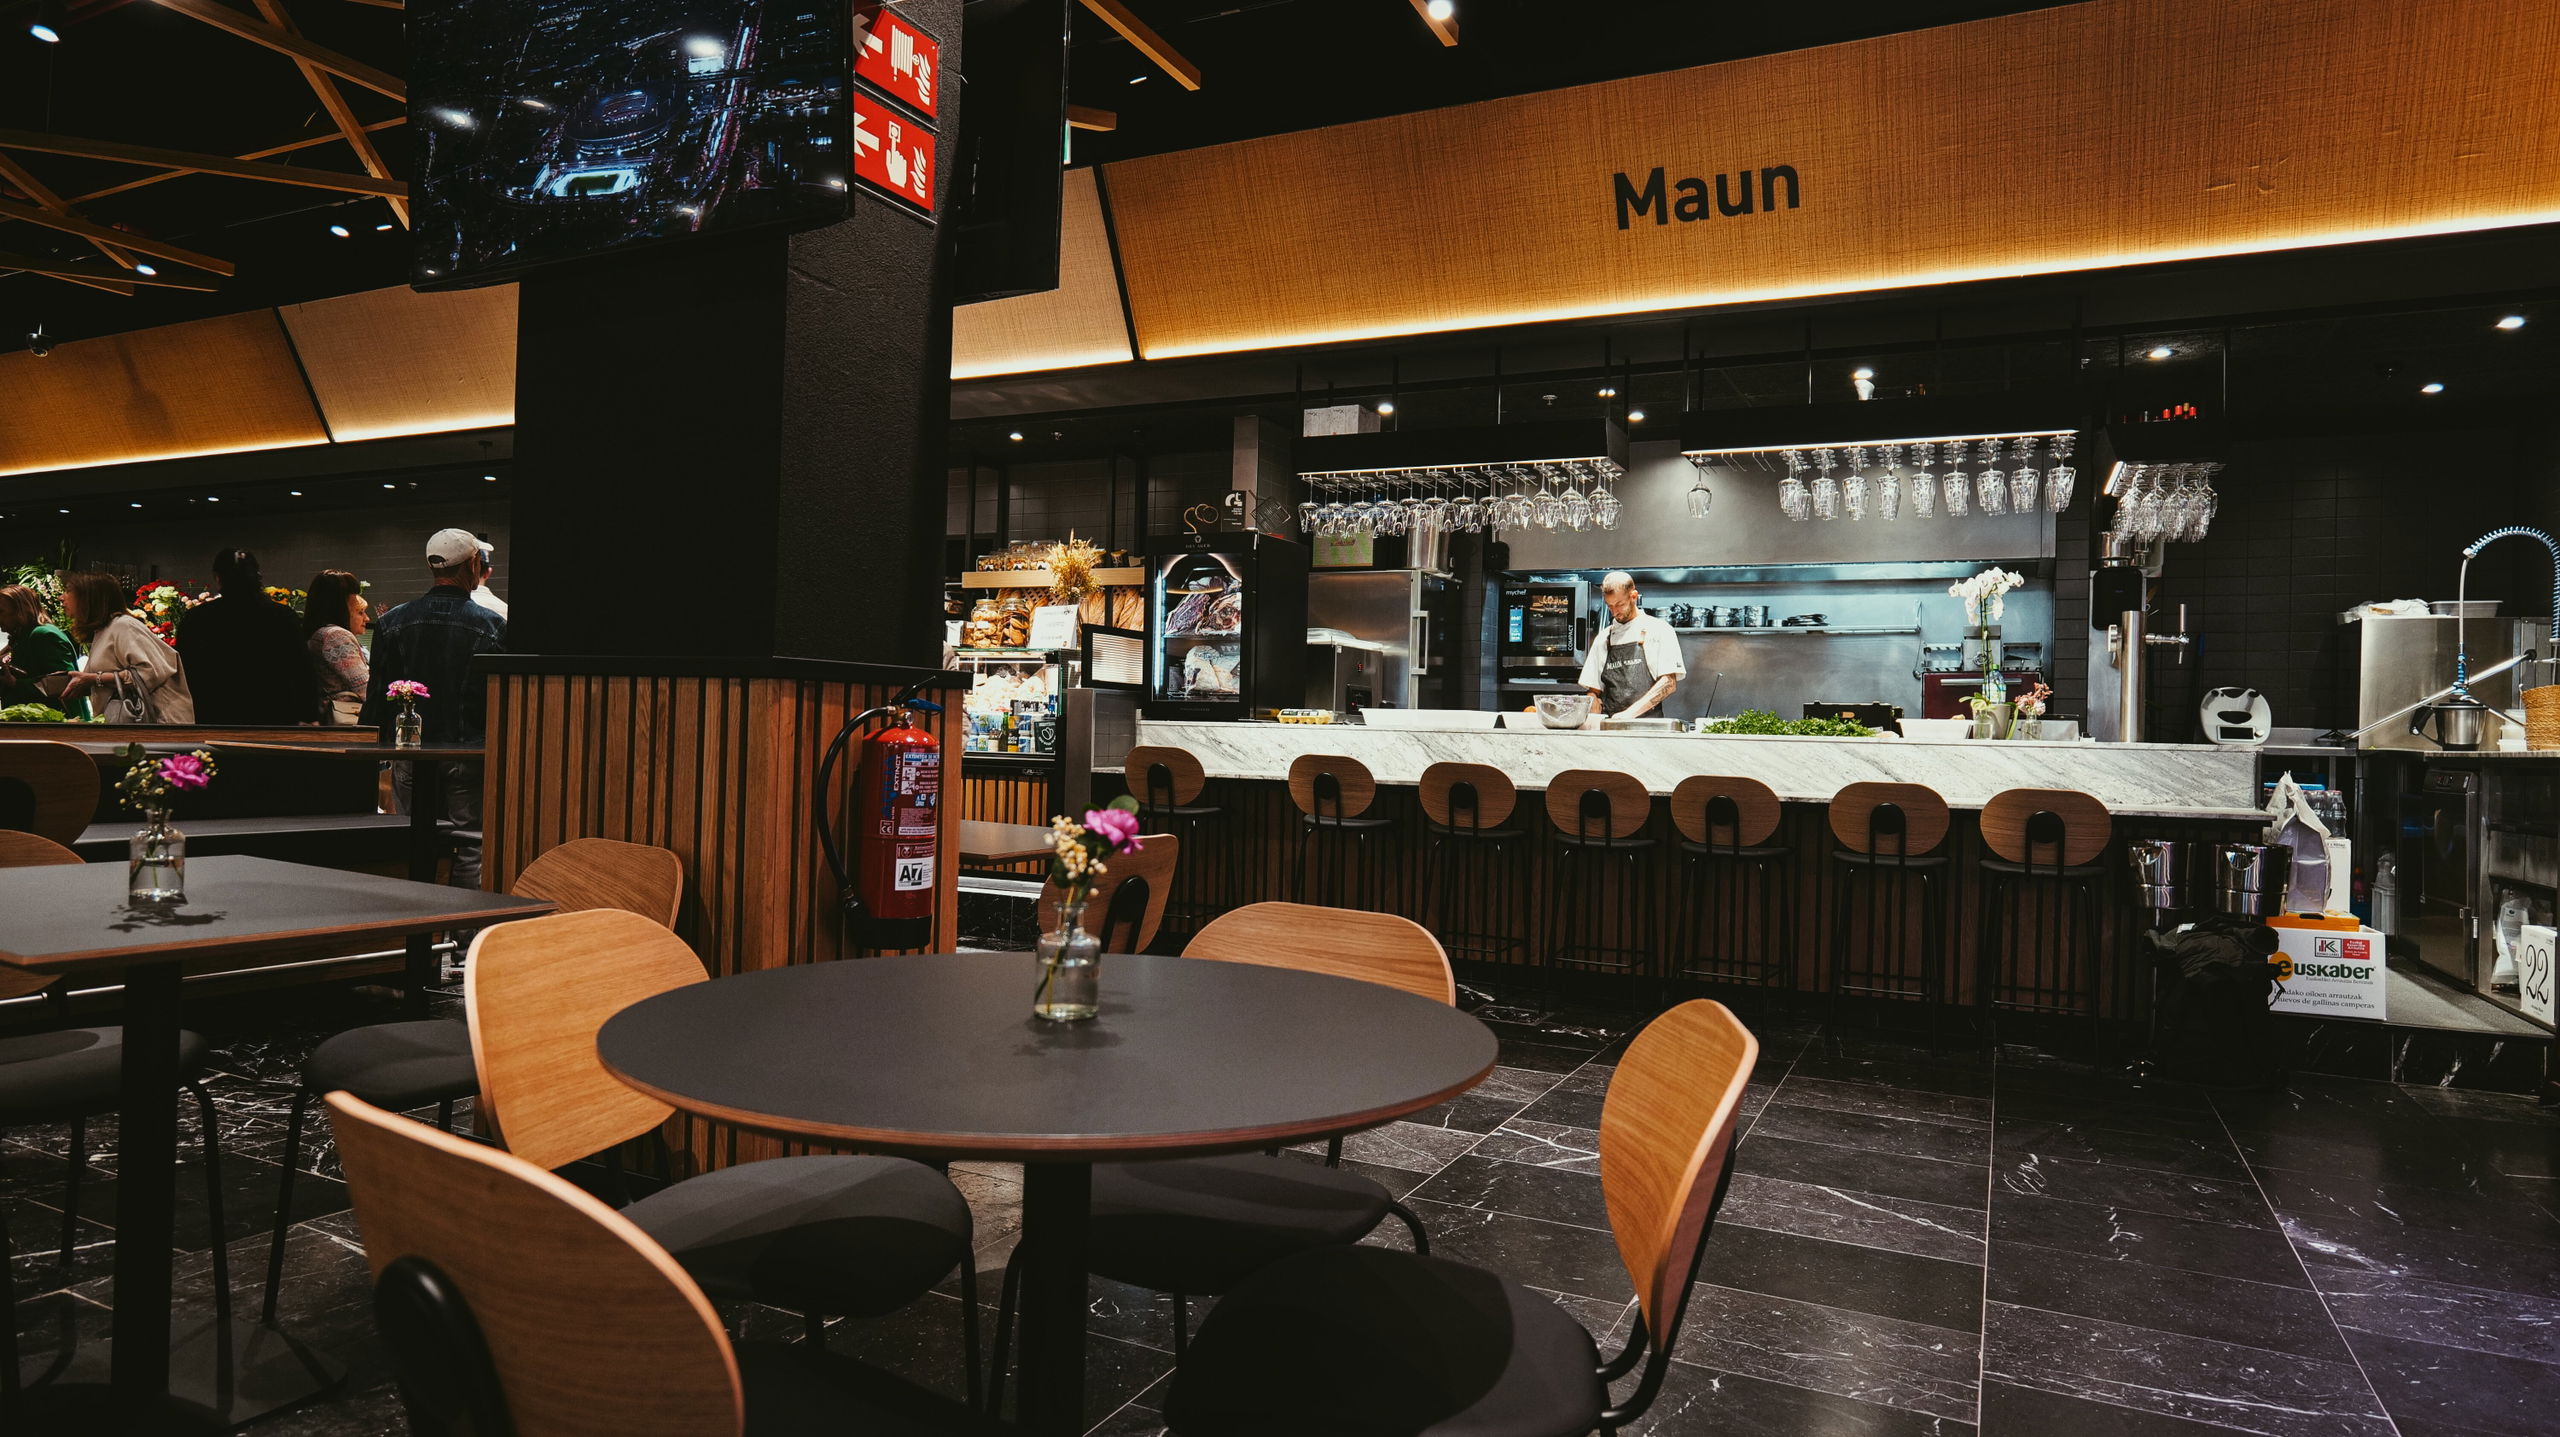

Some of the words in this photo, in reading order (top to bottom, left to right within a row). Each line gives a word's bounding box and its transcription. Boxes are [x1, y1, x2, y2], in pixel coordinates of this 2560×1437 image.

[1613, 164, 1799, 230] Maun
[893, 754, 901, 791] EXTINCT
[2526, 944, 2550, 1005] 22
[2312, 999, 2340, 1008] gallinas
[2340, 1002, 2375, 1010] camperas
